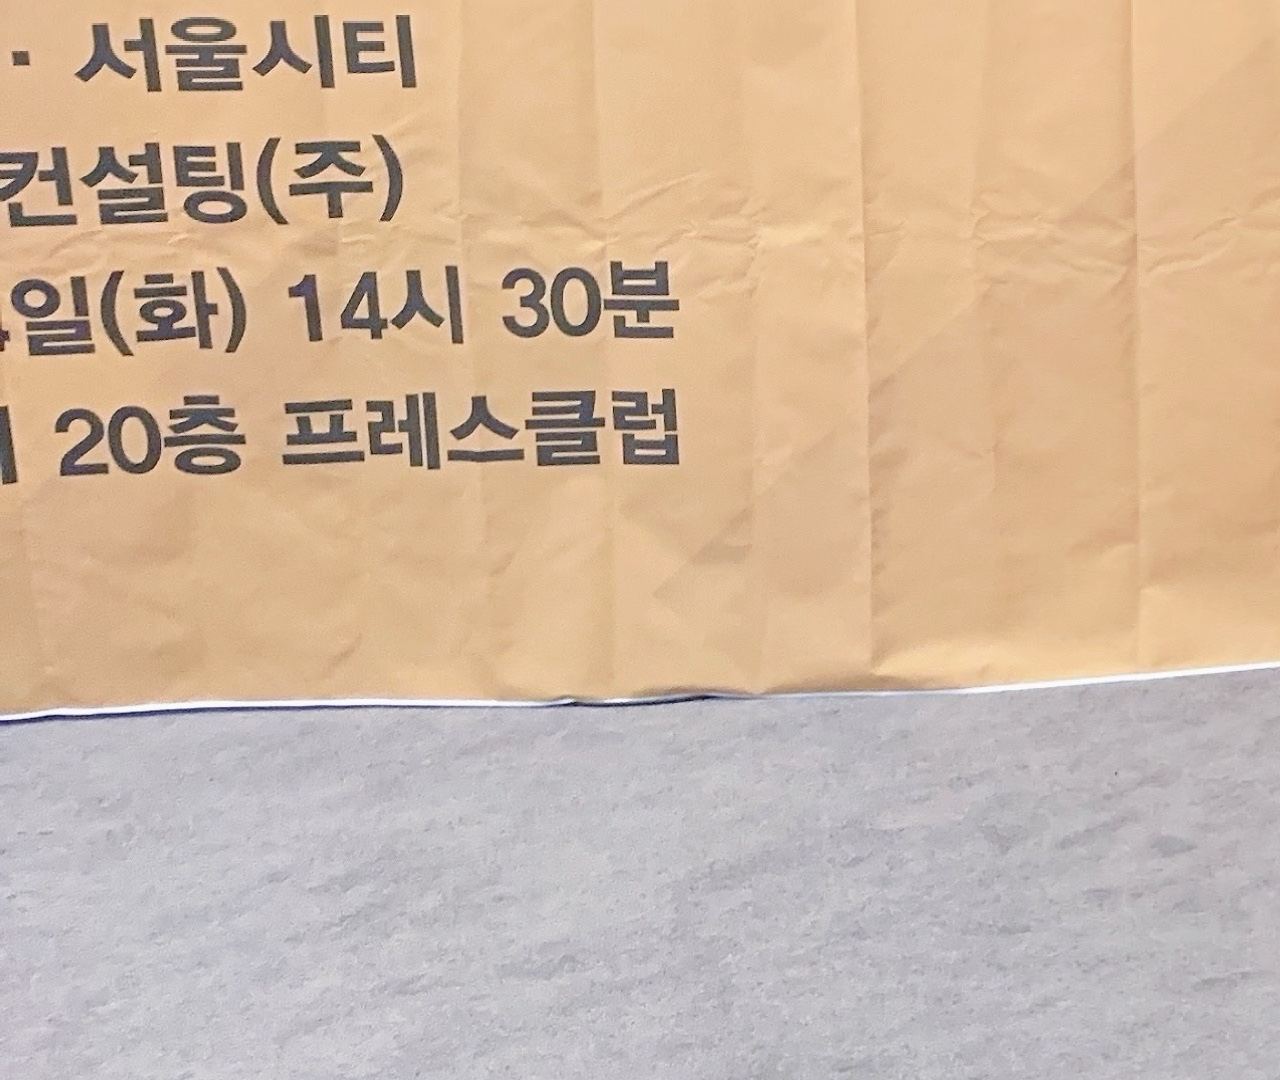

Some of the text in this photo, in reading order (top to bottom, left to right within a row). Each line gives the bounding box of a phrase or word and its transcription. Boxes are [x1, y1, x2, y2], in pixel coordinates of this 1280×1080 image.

[75, 15, 416, 92] 서울시티
[0, 135, 403, 227] 컨설팅(주)
[0, 261, 679, 356] 일(화) 14시 30분
[55, 395, 246, 476] 20층
[282, 389, 679, 470] 프레스클럽
